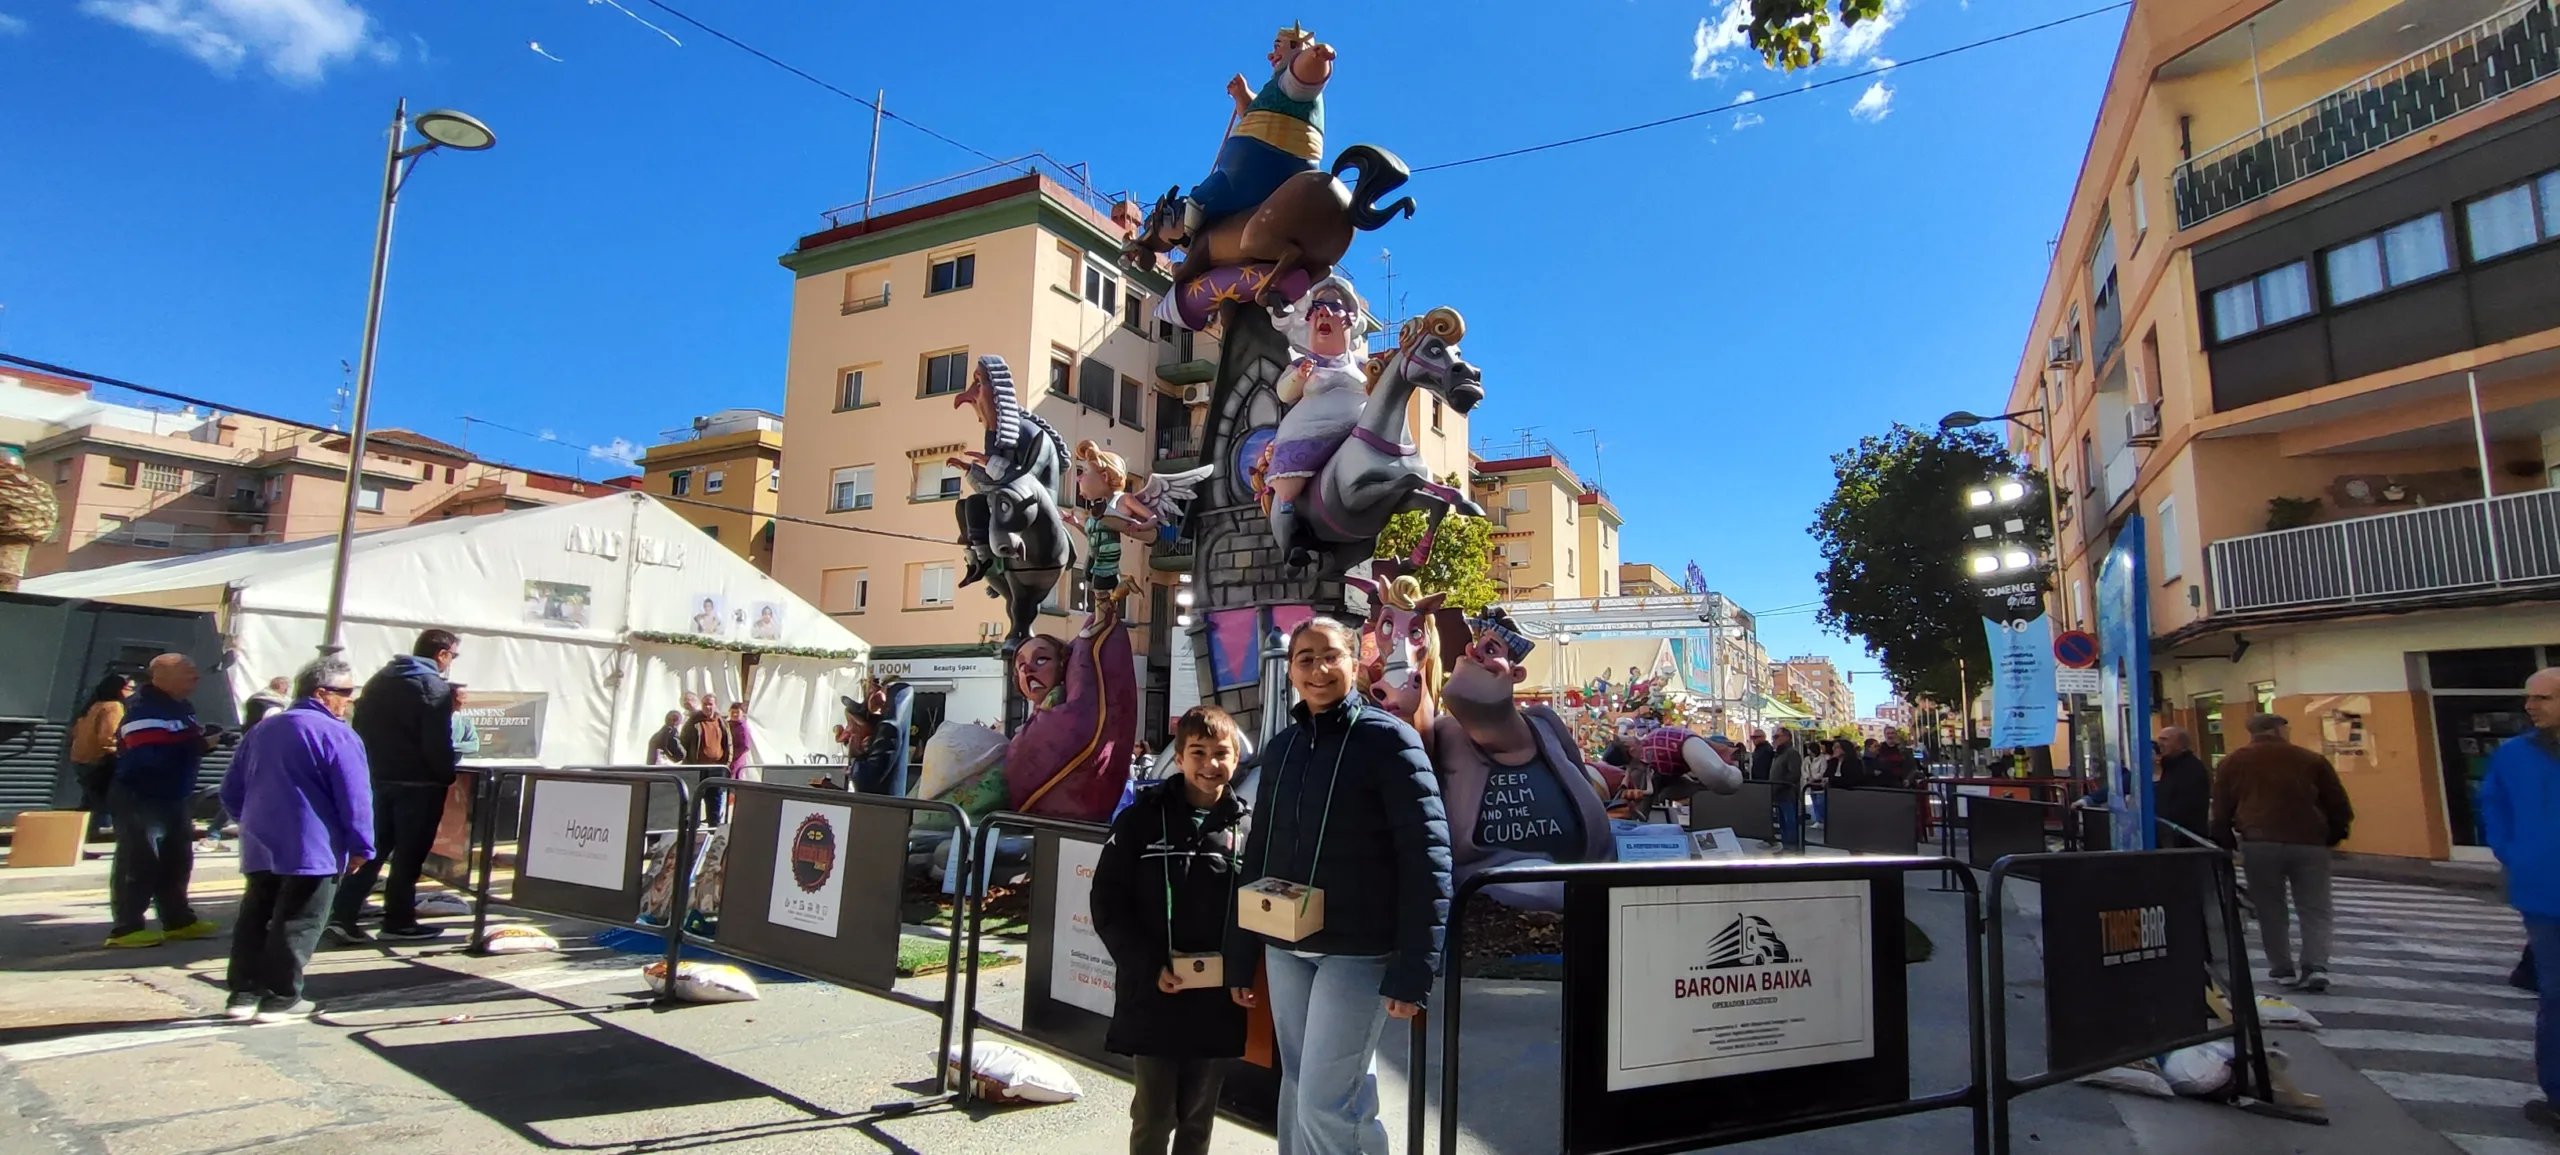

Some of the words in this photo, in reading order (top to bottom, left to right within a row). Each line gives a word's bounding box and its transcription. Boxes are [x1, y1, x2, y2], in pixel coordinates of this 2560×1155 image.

[879, 662, 911, 674] ROOM
[480, 717, 493, 726] DE
[494, 717, 531, 726] VERITAT
[1490, 773, 1528, 786] KEEP
[1484, 787, 1535, 806] CALM
[1480, 809, 1503, 821] AND
[1507, 805, 1531, 818] THE
[1483, 818, 1563, 844] CUBATA
[1675, 973, 1757, 998] BARONIA
[1762, 968, 1812, 991] BAIXA
[1712, 1000, 1745, 1009] OPERADOR
